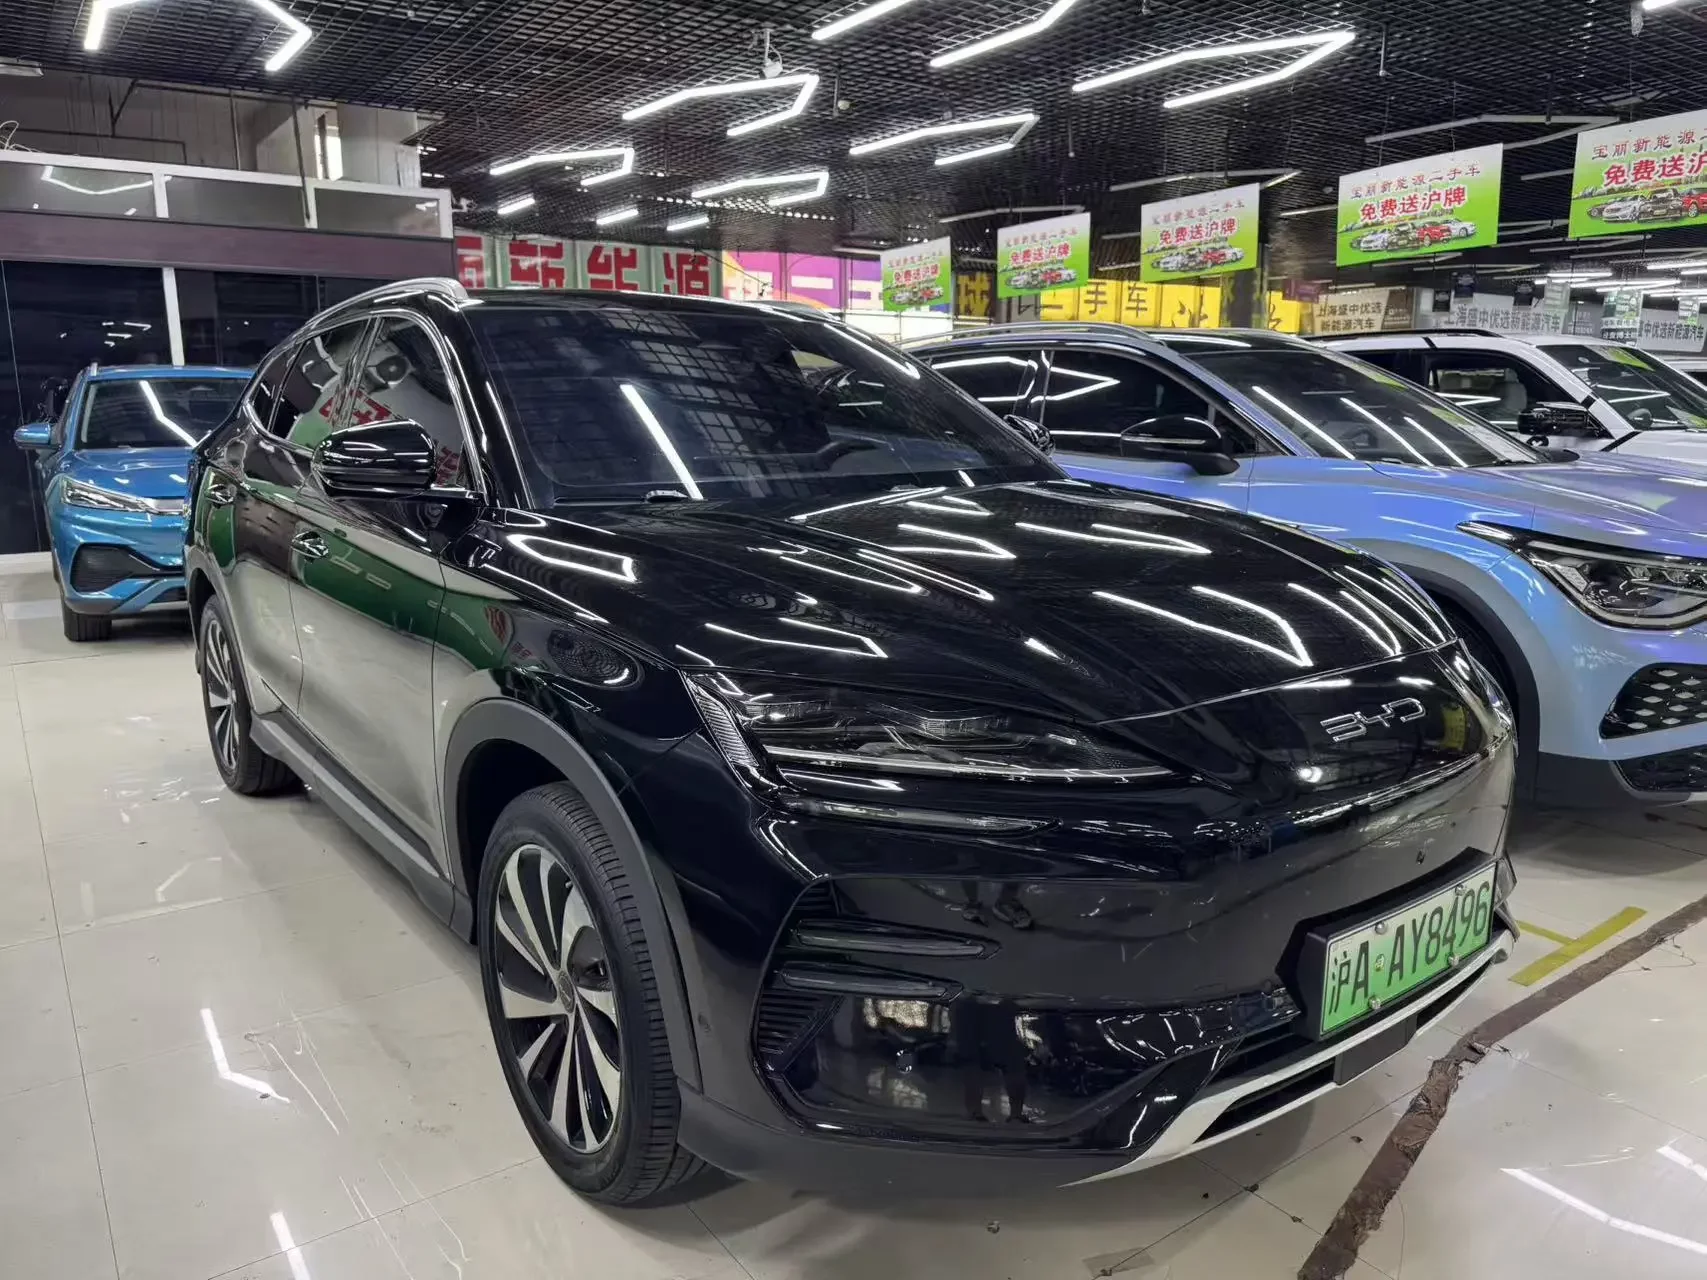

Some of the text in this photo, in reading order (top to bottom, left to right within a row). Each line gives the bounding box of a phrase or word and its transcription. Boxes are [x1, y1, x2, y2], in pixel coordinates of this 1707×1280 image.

[1360, 186, 1466, 221] 免费送沪牌
[1159, 217, 1237, 245] 免费送沪牌
[1319, 696, 1426, 743] BYD
